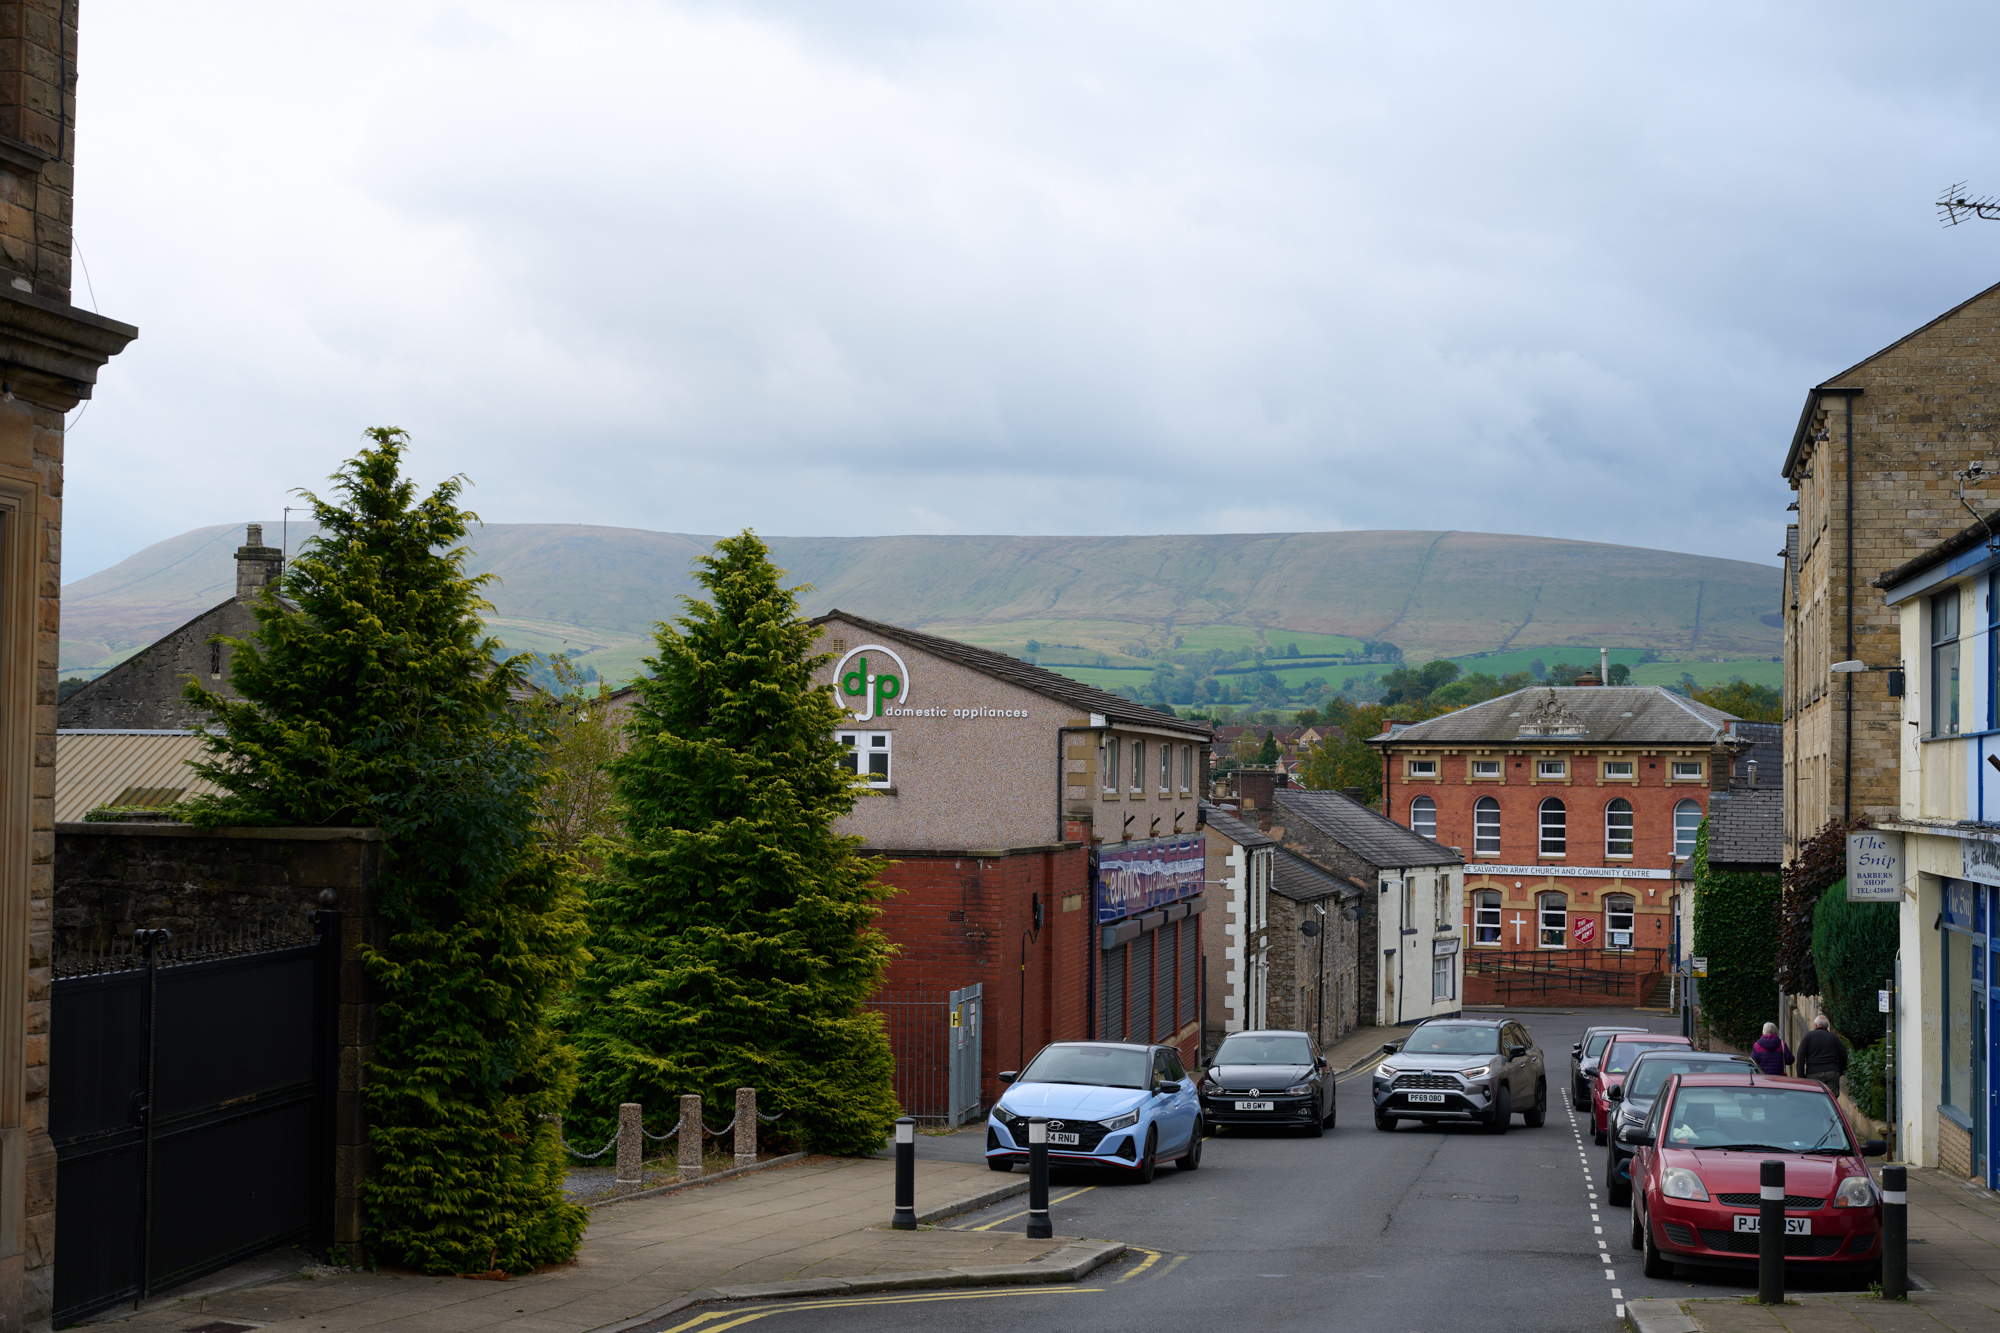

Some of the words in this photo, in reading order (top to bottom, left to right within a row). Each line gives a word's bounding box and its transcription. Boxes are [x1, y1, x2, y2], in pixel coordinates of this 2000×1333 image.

[843, 657, 900, 722] djp
[886, 706, 947, 717] domestic
[953, 707, 1028, 719] appliances
[1853, 836, 1886, 849] The
[1859, 853, 1896, 869] Snip
[1530, 867, 1560, 875] CHURCH
[1578, 868, 1620, 876] COMMUNITY
[1622, 869, 1650, 877] CENTRE
[1410, 1094, 1428, 1102] PF69
[1242, 1102, 1251, 1110] L8
[1058, 1134, 1076, 1143] RNU
